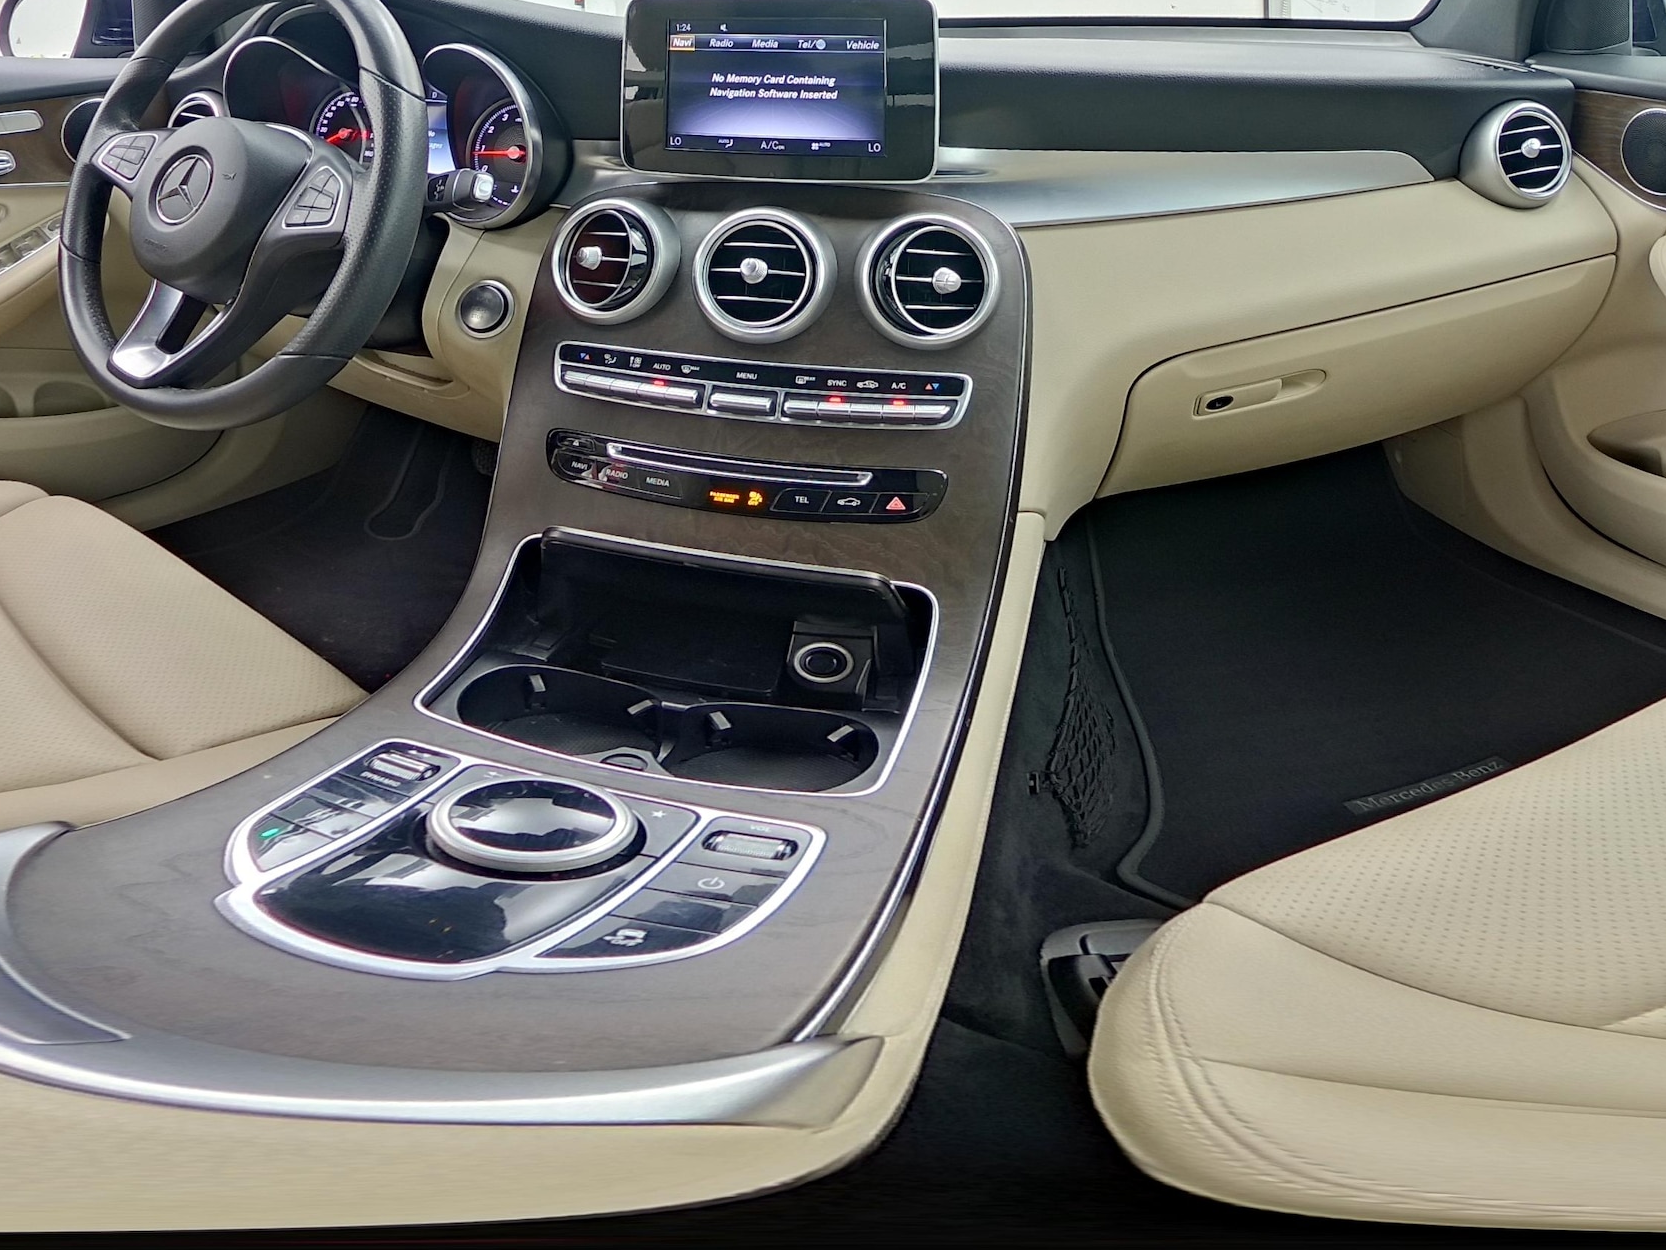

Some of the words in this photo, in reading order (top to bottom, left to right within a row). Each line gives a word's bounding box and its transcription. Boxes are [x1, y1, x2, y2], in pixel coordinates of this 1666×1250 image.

[675, 23, 691, 32] 1:24
[672, 38, 693, 47] Navi
[709, 38, 734, 48] Radio
[751, 39, 779, 48] Media
[846, 40, 880, 50] Vehicle
[711, 73, 725, 83] No
[725, 73, 762, 86] Memory
[763, 74, 785, 84] Card
[786, 75, 836, 87] Containing
[709, 87, 756, 99] Navigation
[757, 88, 799, 99] Software
[799, 89, 838, 100] Inserted
[501, 113, 509, 122] 3
[487, 125, 495, 134] 2
[669, 136, 682, 146] LO
[868, 143, 881, 152] LO
[652, 363, 672, 371] AUTO
[735, 371, 758, 380] MENU
[827, 379, 848, 388] SYNC
[891, 381, 906, 390] A/C
[571, 460, 589, 470] NAVI
[605, 469, 629, 479] RADIO
[645, 476, 670, 487] MEDIA
[794, 495, 809, 504] TEL
[359, 771, 402, 788] DYNAMIC
[1355, 760, 1504, 813] Mercedes-Benz
[749, 823, 772, 832] VOL
